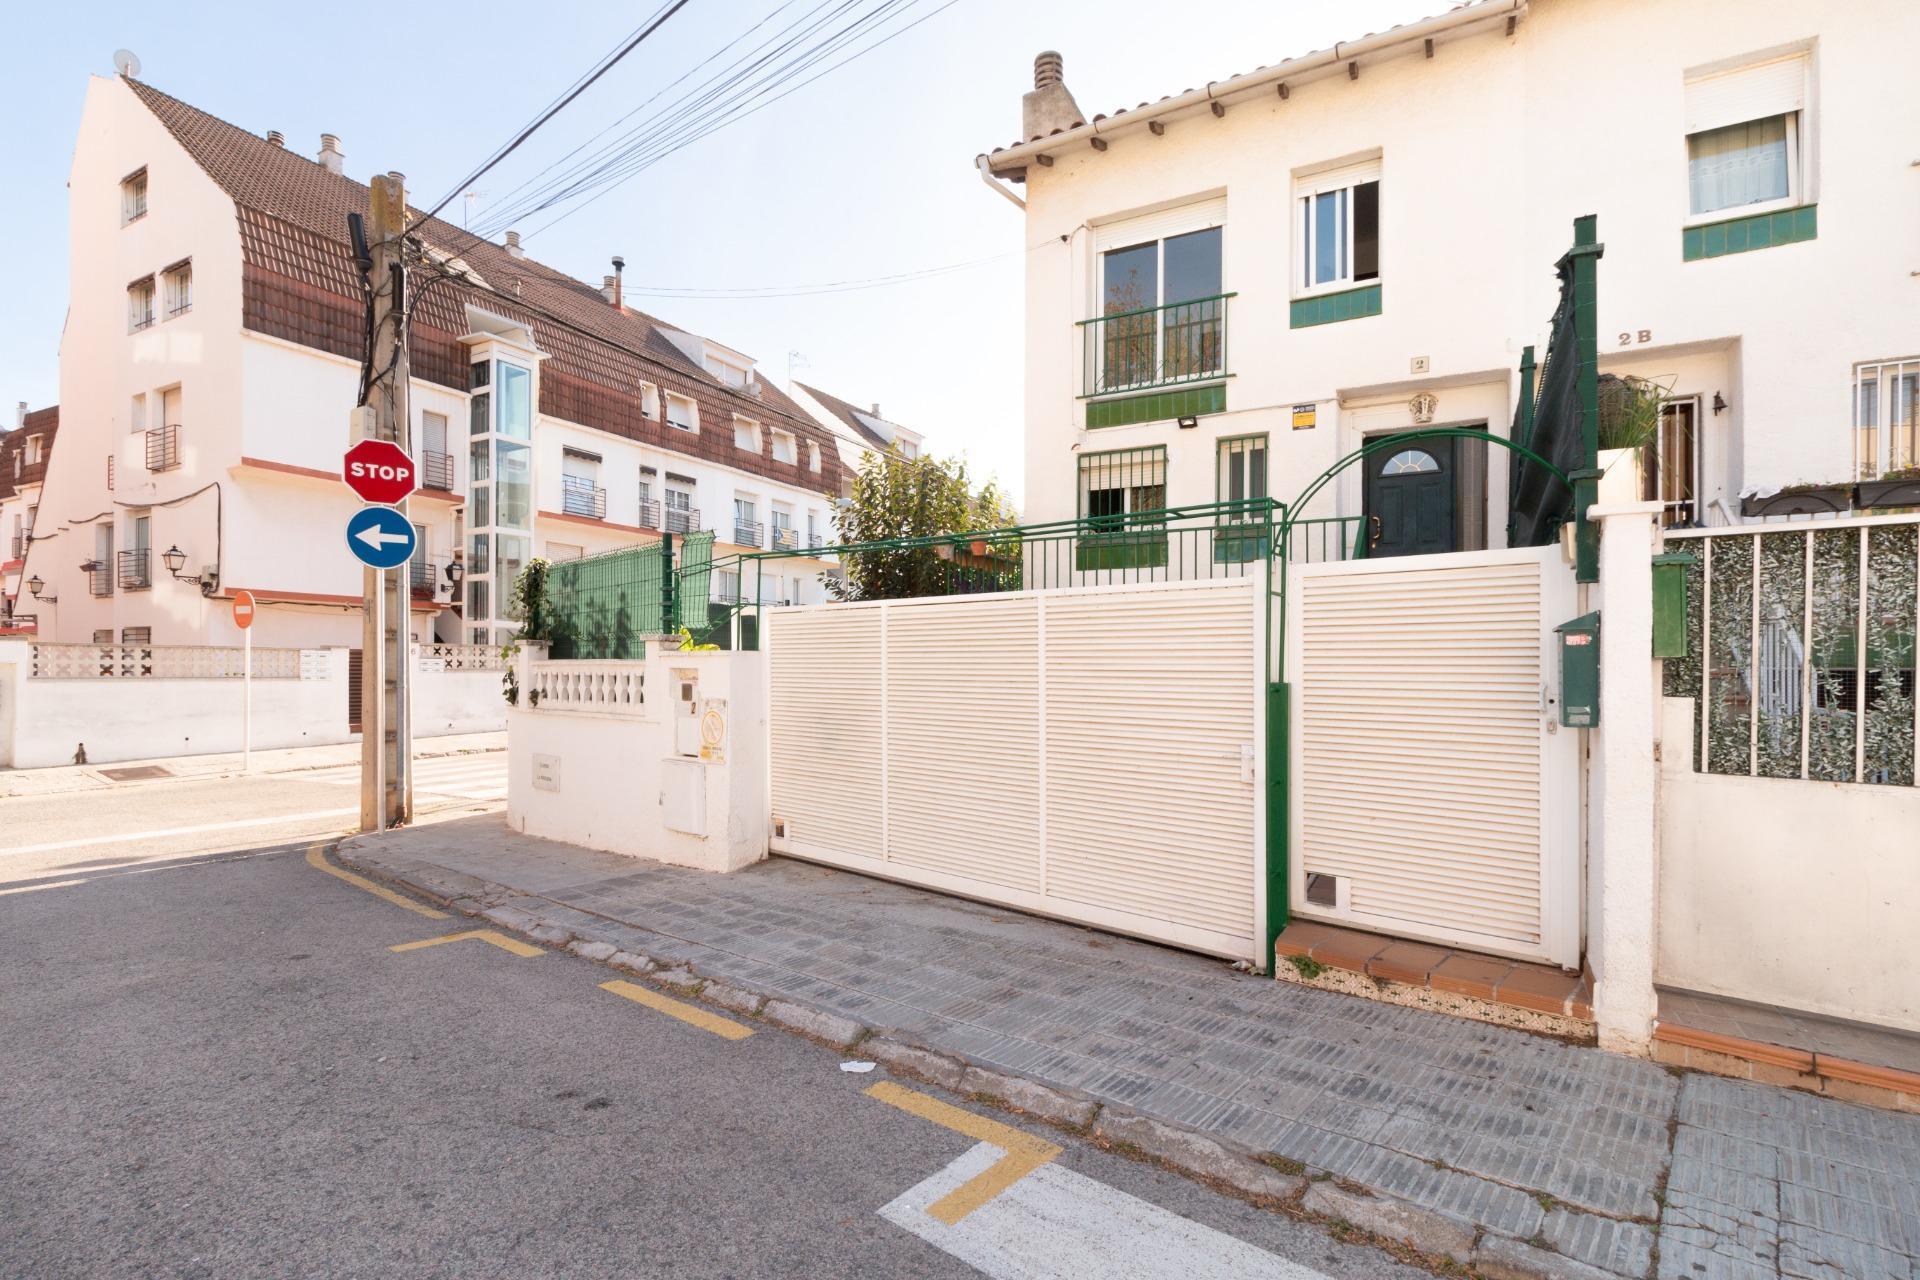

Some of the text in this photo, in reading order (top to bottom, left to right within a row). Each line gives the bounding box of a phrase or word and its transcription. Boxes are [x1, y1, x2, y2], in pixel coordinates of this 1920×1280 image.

[1416, 360, 1424, 369] 2
[351, 462, 410, 482] STOP
[691, 702, 696, 714] 2
